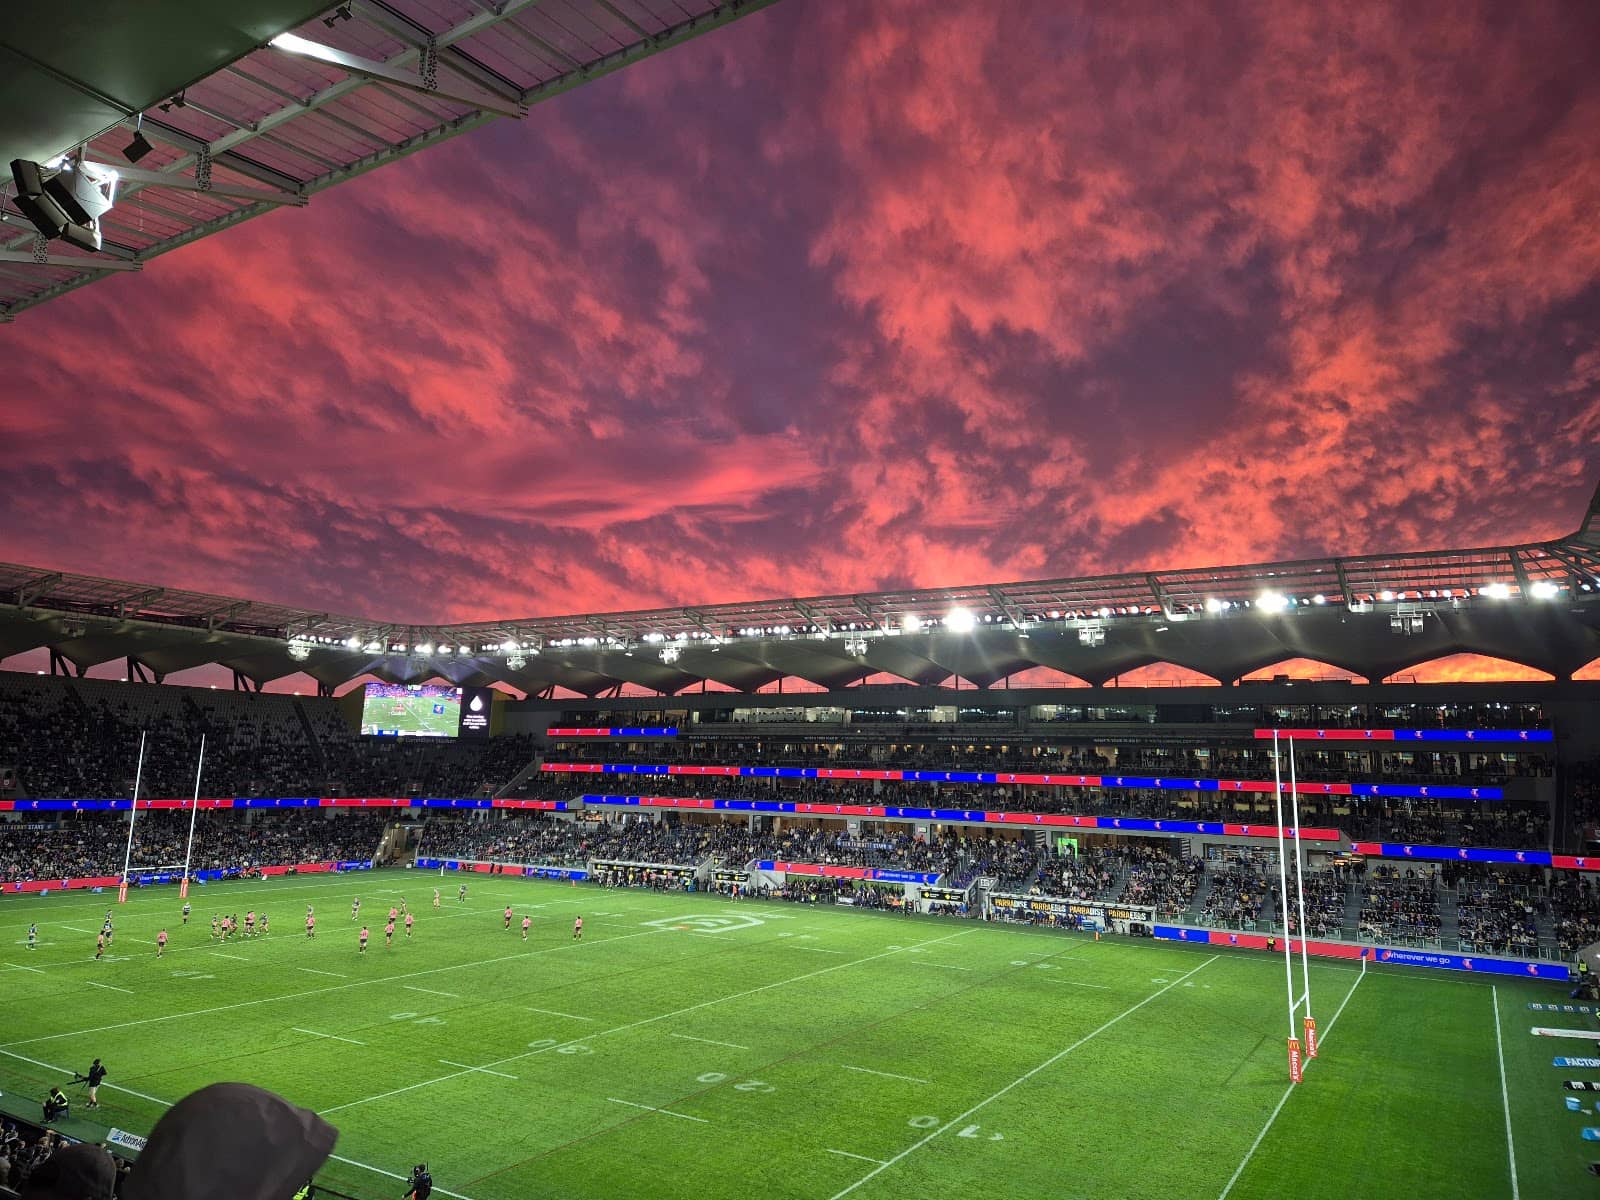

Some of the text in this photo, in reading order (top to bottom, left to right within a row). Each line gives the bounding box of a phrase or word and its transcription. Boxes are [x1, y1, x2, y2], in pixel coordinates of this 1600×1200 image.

[995, 899, 1028, 909] PARRADISE
[1069, 905, 1105, 917] PARRADISE
[1388, 951, 1424, 961] wherever
[1439, 957, 1451, 965] go
